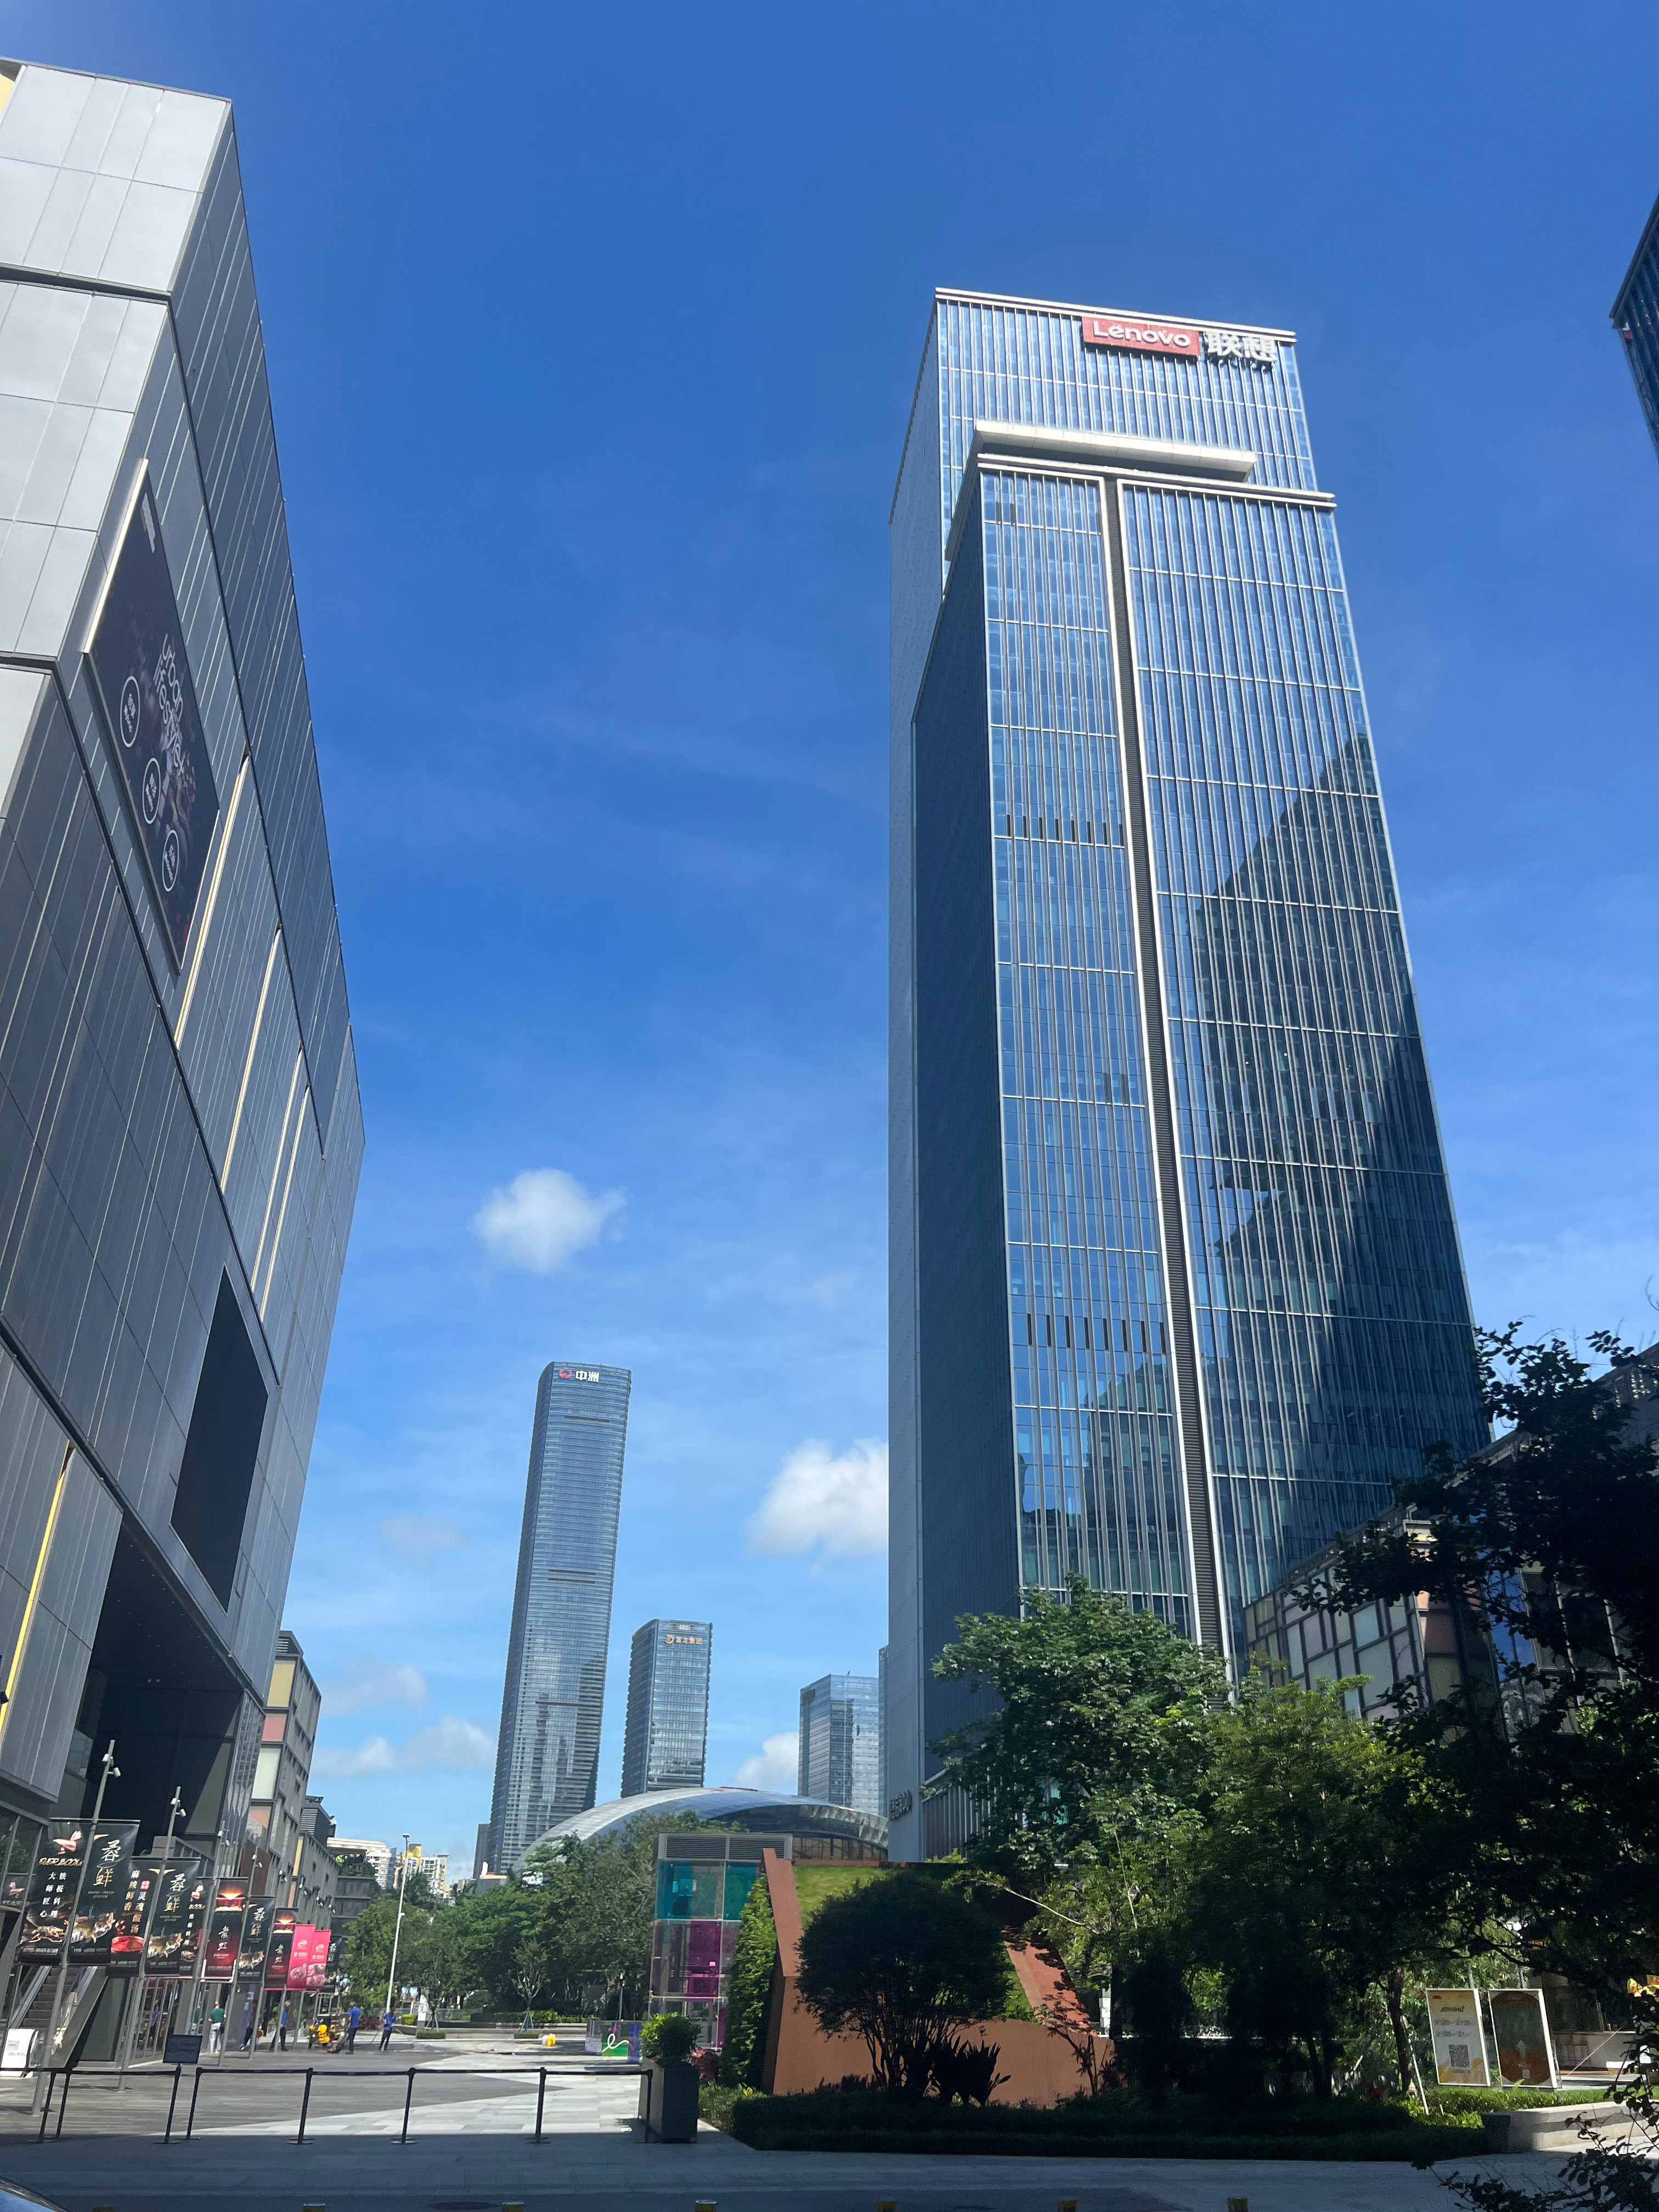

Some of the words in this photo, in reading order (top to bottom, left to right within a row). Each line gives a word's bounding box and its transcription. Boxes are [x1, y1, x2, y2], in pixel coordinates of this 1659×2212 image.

[1093, 320, 1192, 348] Lenovo
[1206, 331, 1278, 362] 联想
[575, 1370, 600, 1383] 中洲
